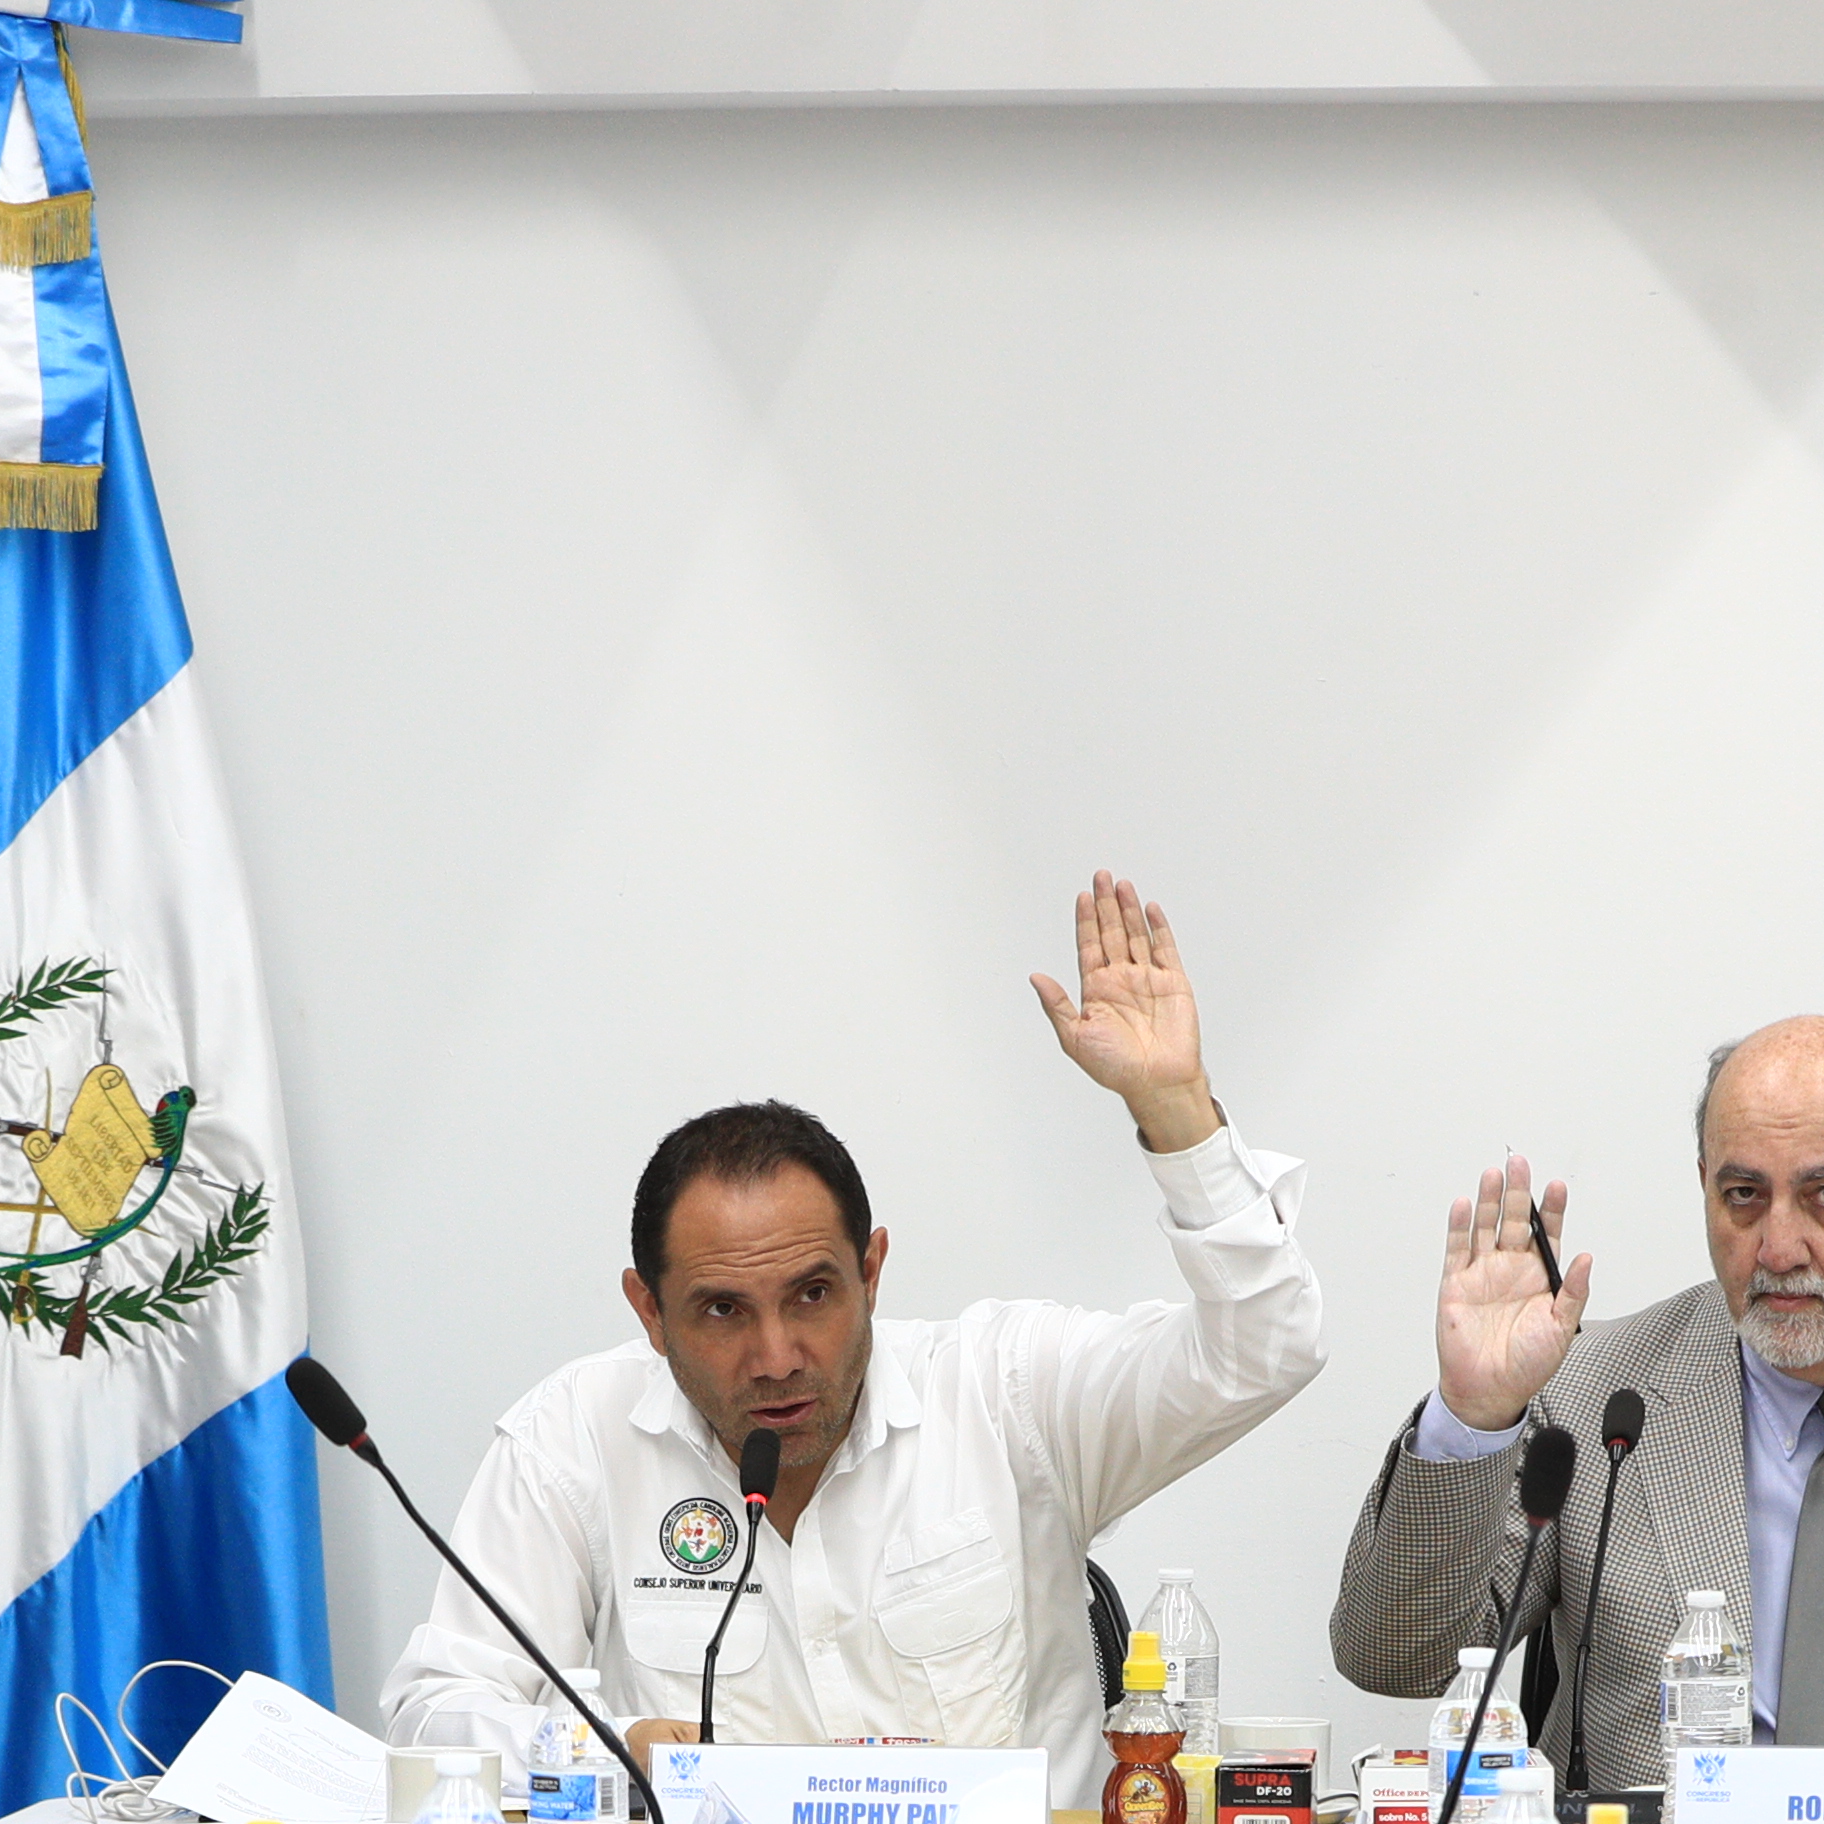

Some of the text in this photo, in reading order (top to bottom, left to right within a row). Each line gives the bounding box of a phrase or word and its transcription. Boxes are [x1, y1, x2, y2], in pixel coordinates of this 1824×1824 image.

[90, 1115, 134, 1174] LIBERTAD
[633, 1577, 667, 1589] CONSEJO
[669, 1578, 706, 1590] SUPERIOR
[807, 1776, 948, 1794] Rector Magnífico
[1233, 1773, 1292, 1787] SUPRA
[1256, 1786, 1292, 1796] DF-20
[1373, 1788, 1406, 1797] Office
[1378, 1812, 1404, 1822] sobre
[1404, 1812, 1420, 1822] No.
